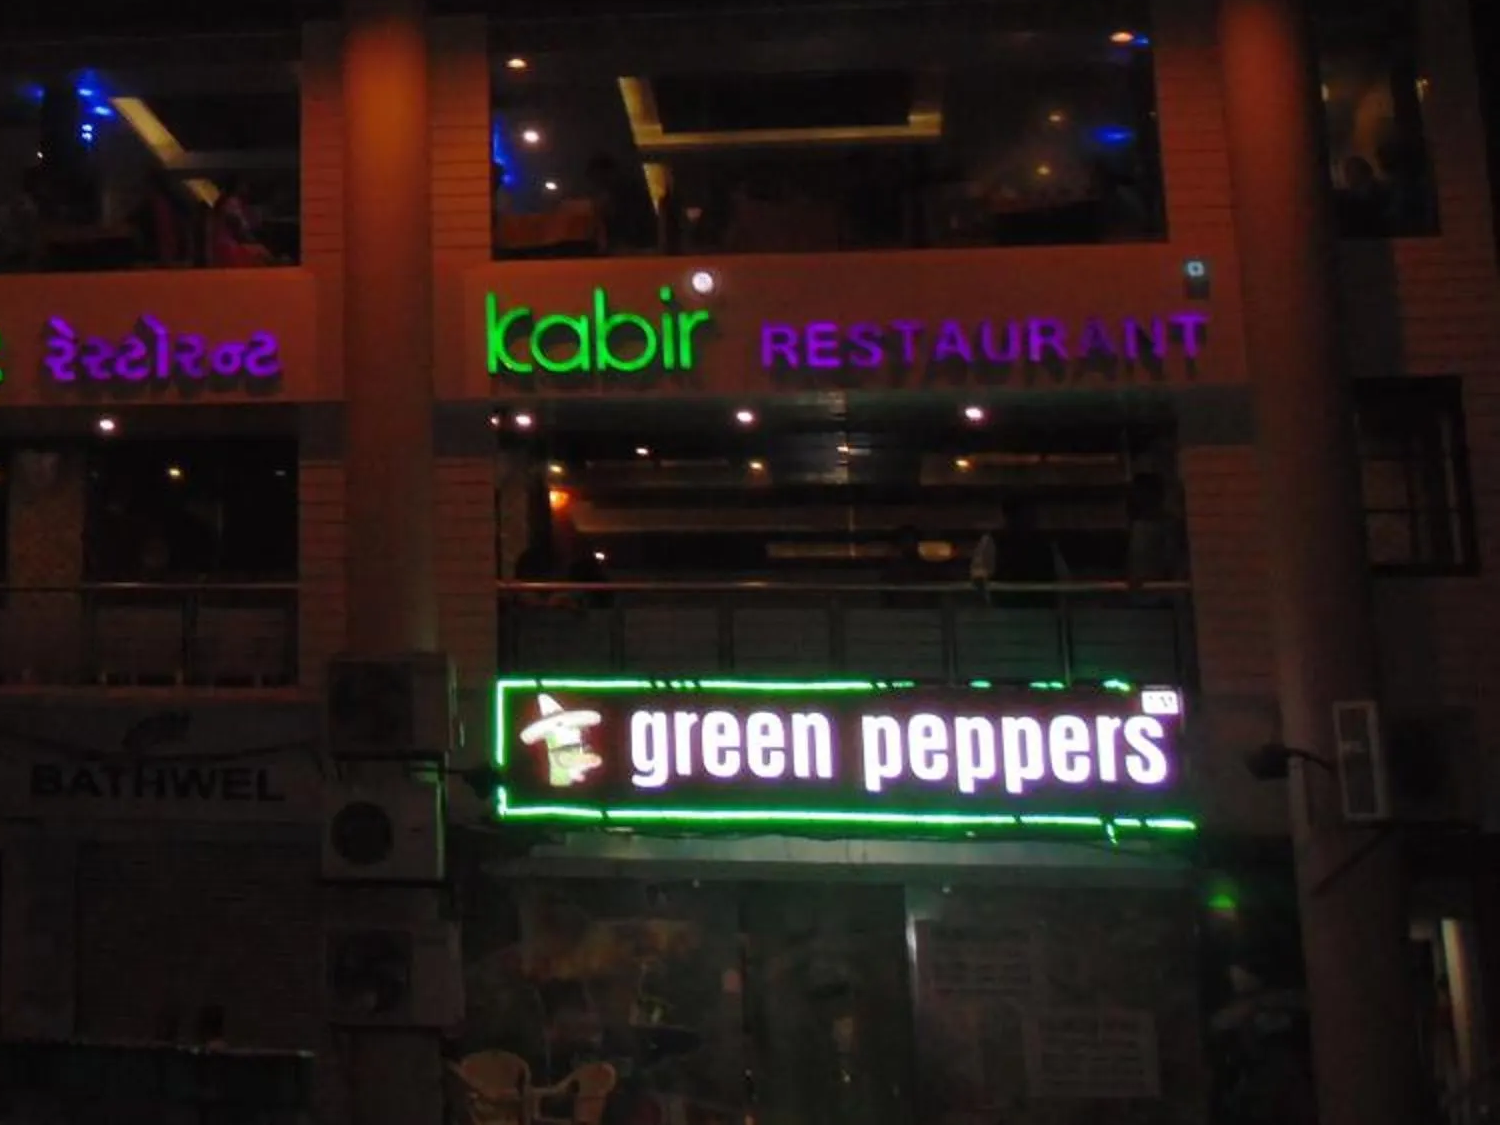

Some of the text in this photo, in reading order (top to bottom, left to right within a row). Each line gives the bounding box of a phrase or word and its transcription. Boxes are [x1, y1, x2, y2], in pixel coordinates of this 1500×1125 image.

[486, 286, 1210, 373] kabir RESTAURANT
[31, 762, 285, 802] BATHWEL
[630, 709, 1169, 794] green peppers
